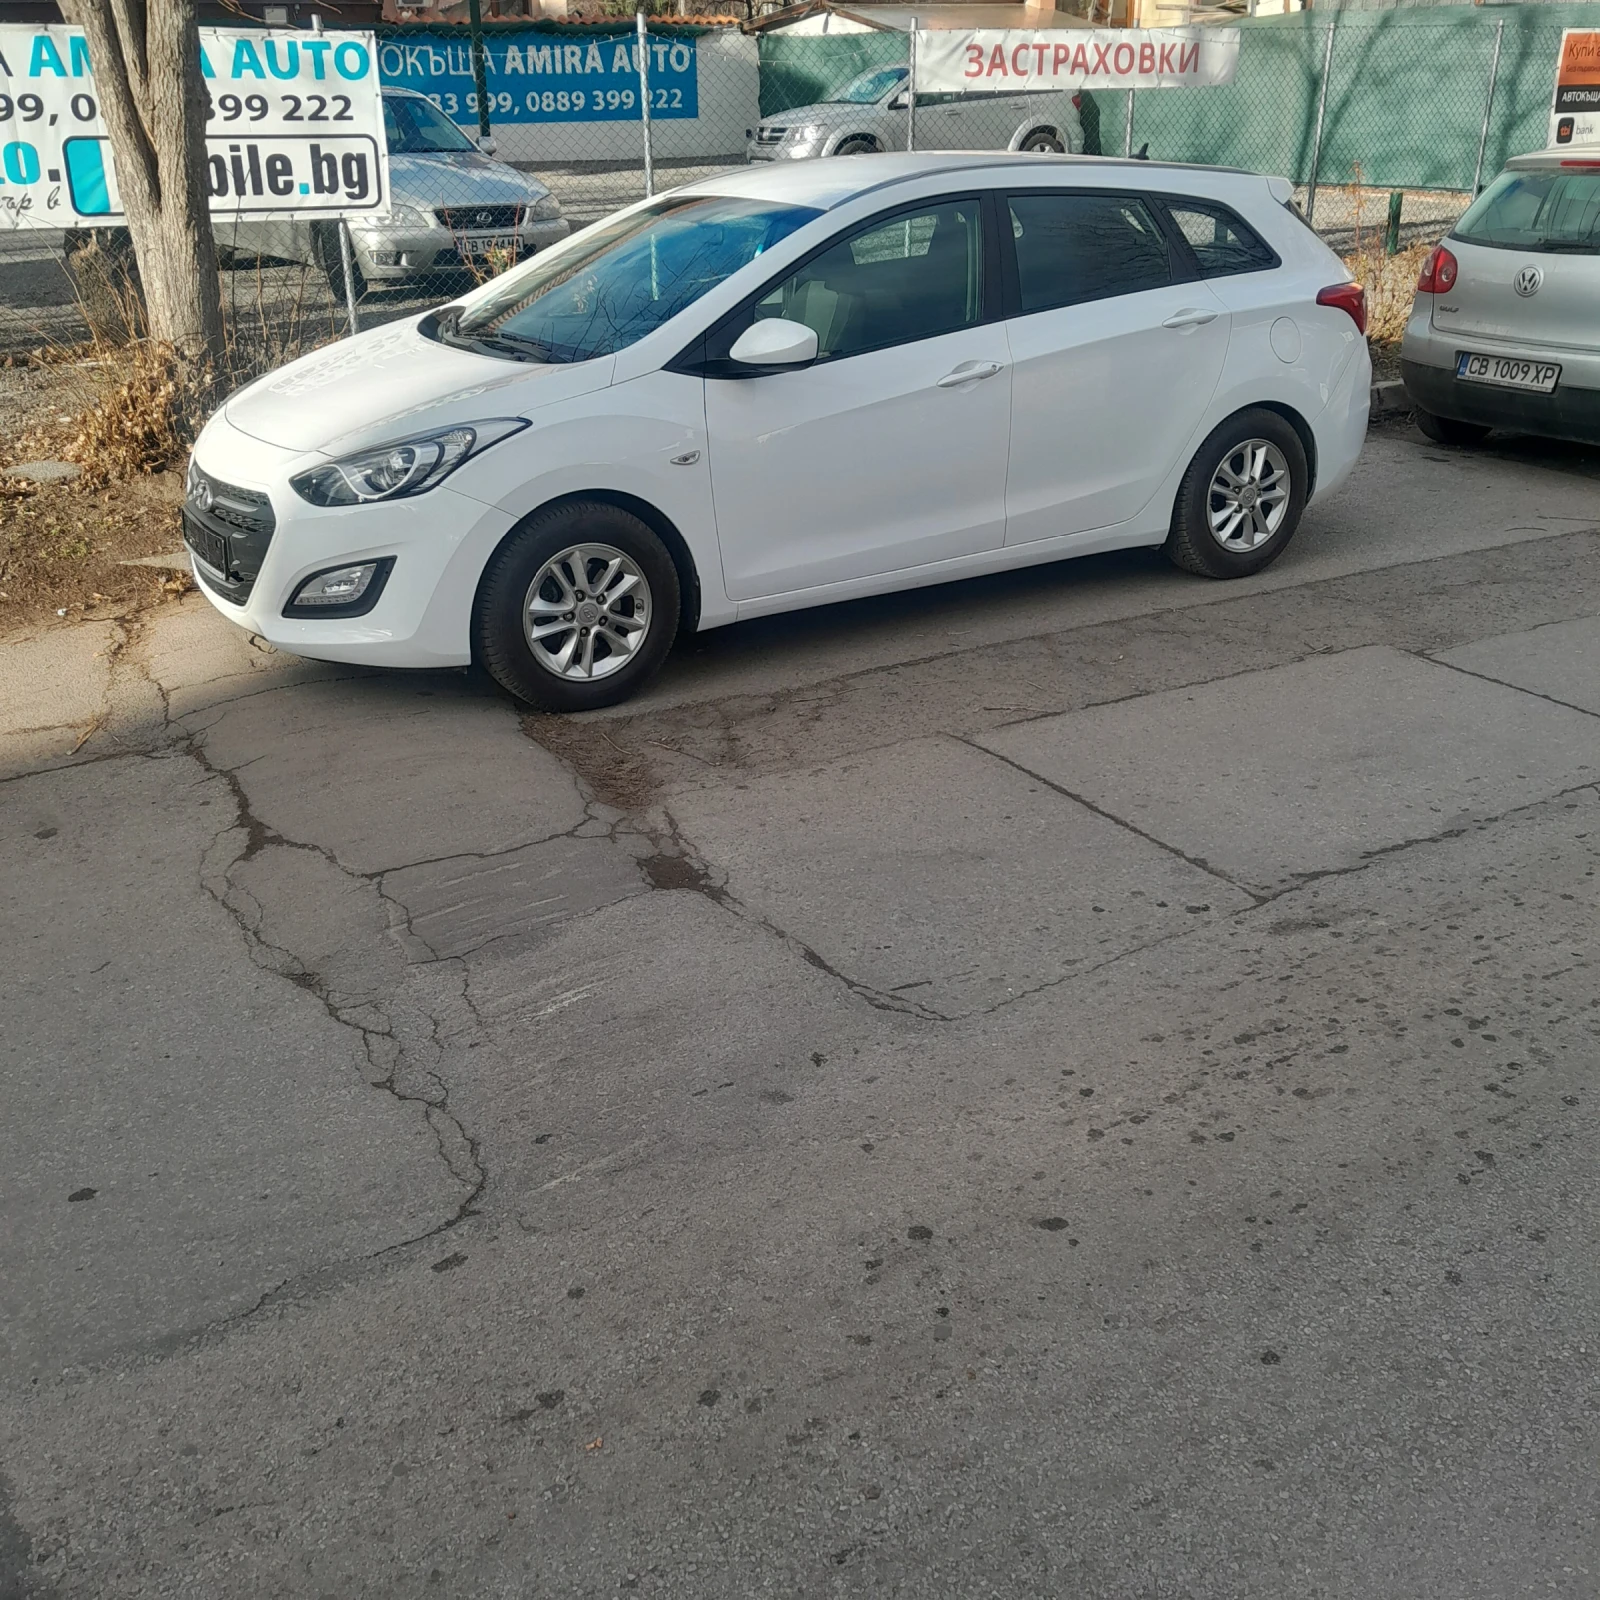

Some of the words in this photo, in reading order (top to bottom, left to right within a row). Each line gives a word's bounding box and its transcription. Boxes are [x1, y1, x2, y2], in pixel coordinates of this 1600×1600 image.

[231, 39, 370, 81] AUTO
[504, 44, 604, 74] AMIRA
[612, 43, 691, 72] AUTO
[964, 42, 1200, 78] ЗАСТРАХОВКИ
[1568, 43, 1594, 60] Купи
[206, 94, 269, 121] 99
[280, 94, 354, 121] 222
[525, 90, 586, 113] 0889
[592, 89, 635, 111] 399
[1575, 125, 1594, 135] bank
[204, 143, 369, 200] bile.bg
[1468, 356, 1490, 376] CB
[1493, 360, 1531, 381] 1009
[1530, 365, 1555, 385] XP
